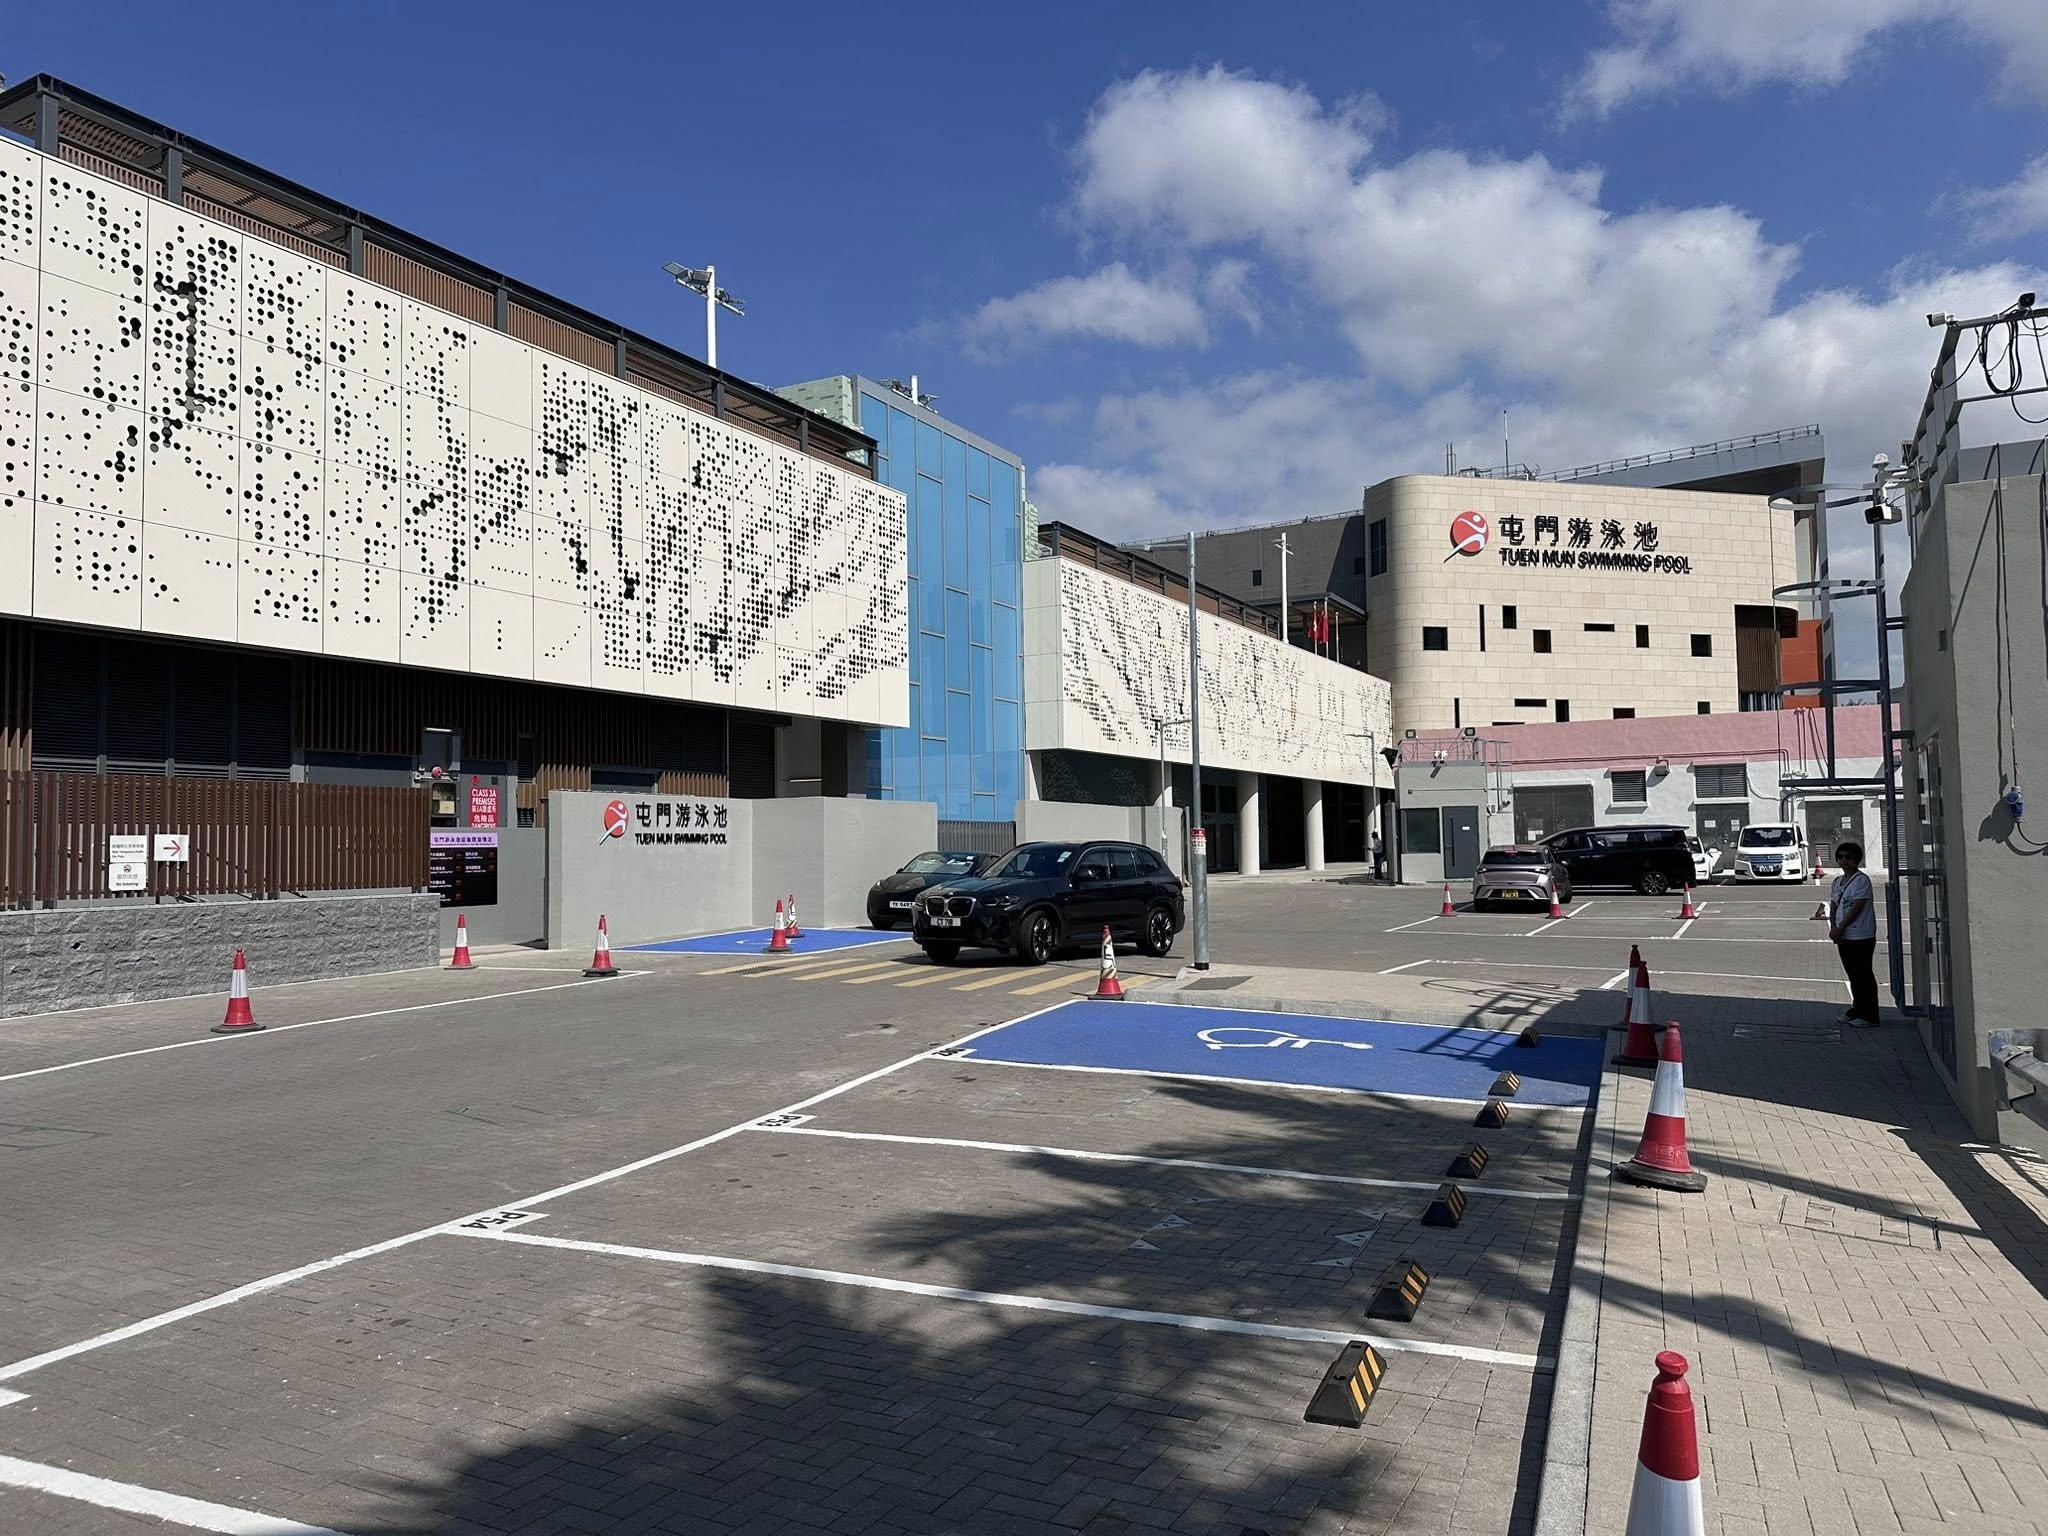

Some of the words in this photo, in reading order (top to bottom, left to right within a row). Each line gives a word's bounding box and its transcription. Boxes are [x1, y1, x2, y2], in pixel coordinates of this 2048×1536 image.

[1499, 514, 1659, 551] 屯門游泳池
[1499, 547, 1540, 567] TUEN
[1542, 549, 1576, 569] MUN
[1577, 551, 1652, 572] SWIMMING
[1654, 554, 1692, 574] POOL
[471, 788, 488, 797] CLASS
[472, 797, 496, 805] PREMISES
[635, 801, 728, 828] 屯門游泳池
[635, 833, 655, 845] TUEN
[656, 833, 672, 845] MUN
[673, 833, 709, 845] SWIMMING
[709, 833, 727, 845] POOL
[459, 1211, 529, 1229] P54
